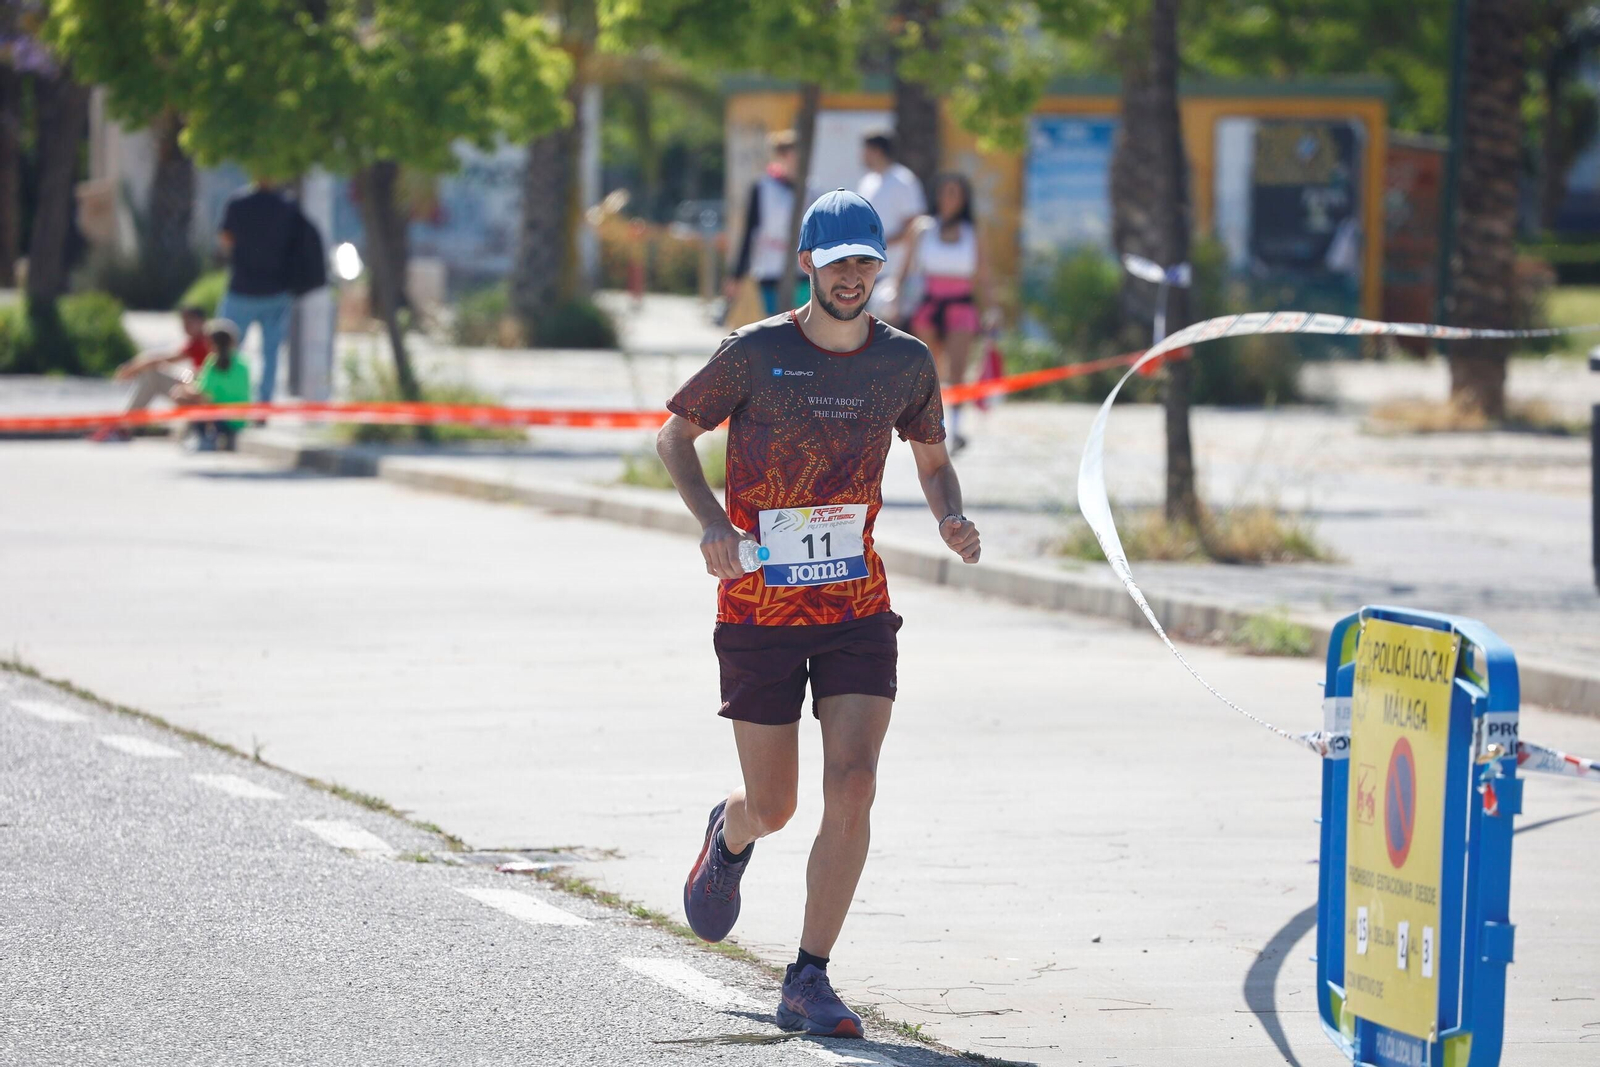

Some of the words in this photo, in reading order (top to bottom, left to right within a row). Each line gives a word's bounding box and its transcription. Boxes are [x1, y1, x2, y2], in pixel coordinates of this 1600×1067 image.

[808, 396, 834, 405] WHAT
[835, 397, 864, 407] ABOUT
[813, 410, 829, 418] THE
[831, 410, 858, 419] LIMITS
[813, 507, 843, 516] RFEA
[810, 514, 856, 524] ATLETISMO
[801, 532, 831, 559] 11
[1373, 640, 1411, 677] POLICÍA
[1413, 648, 1450, 685] LOCAL
[1384, 689, 1428, 731] MÁLAGA
